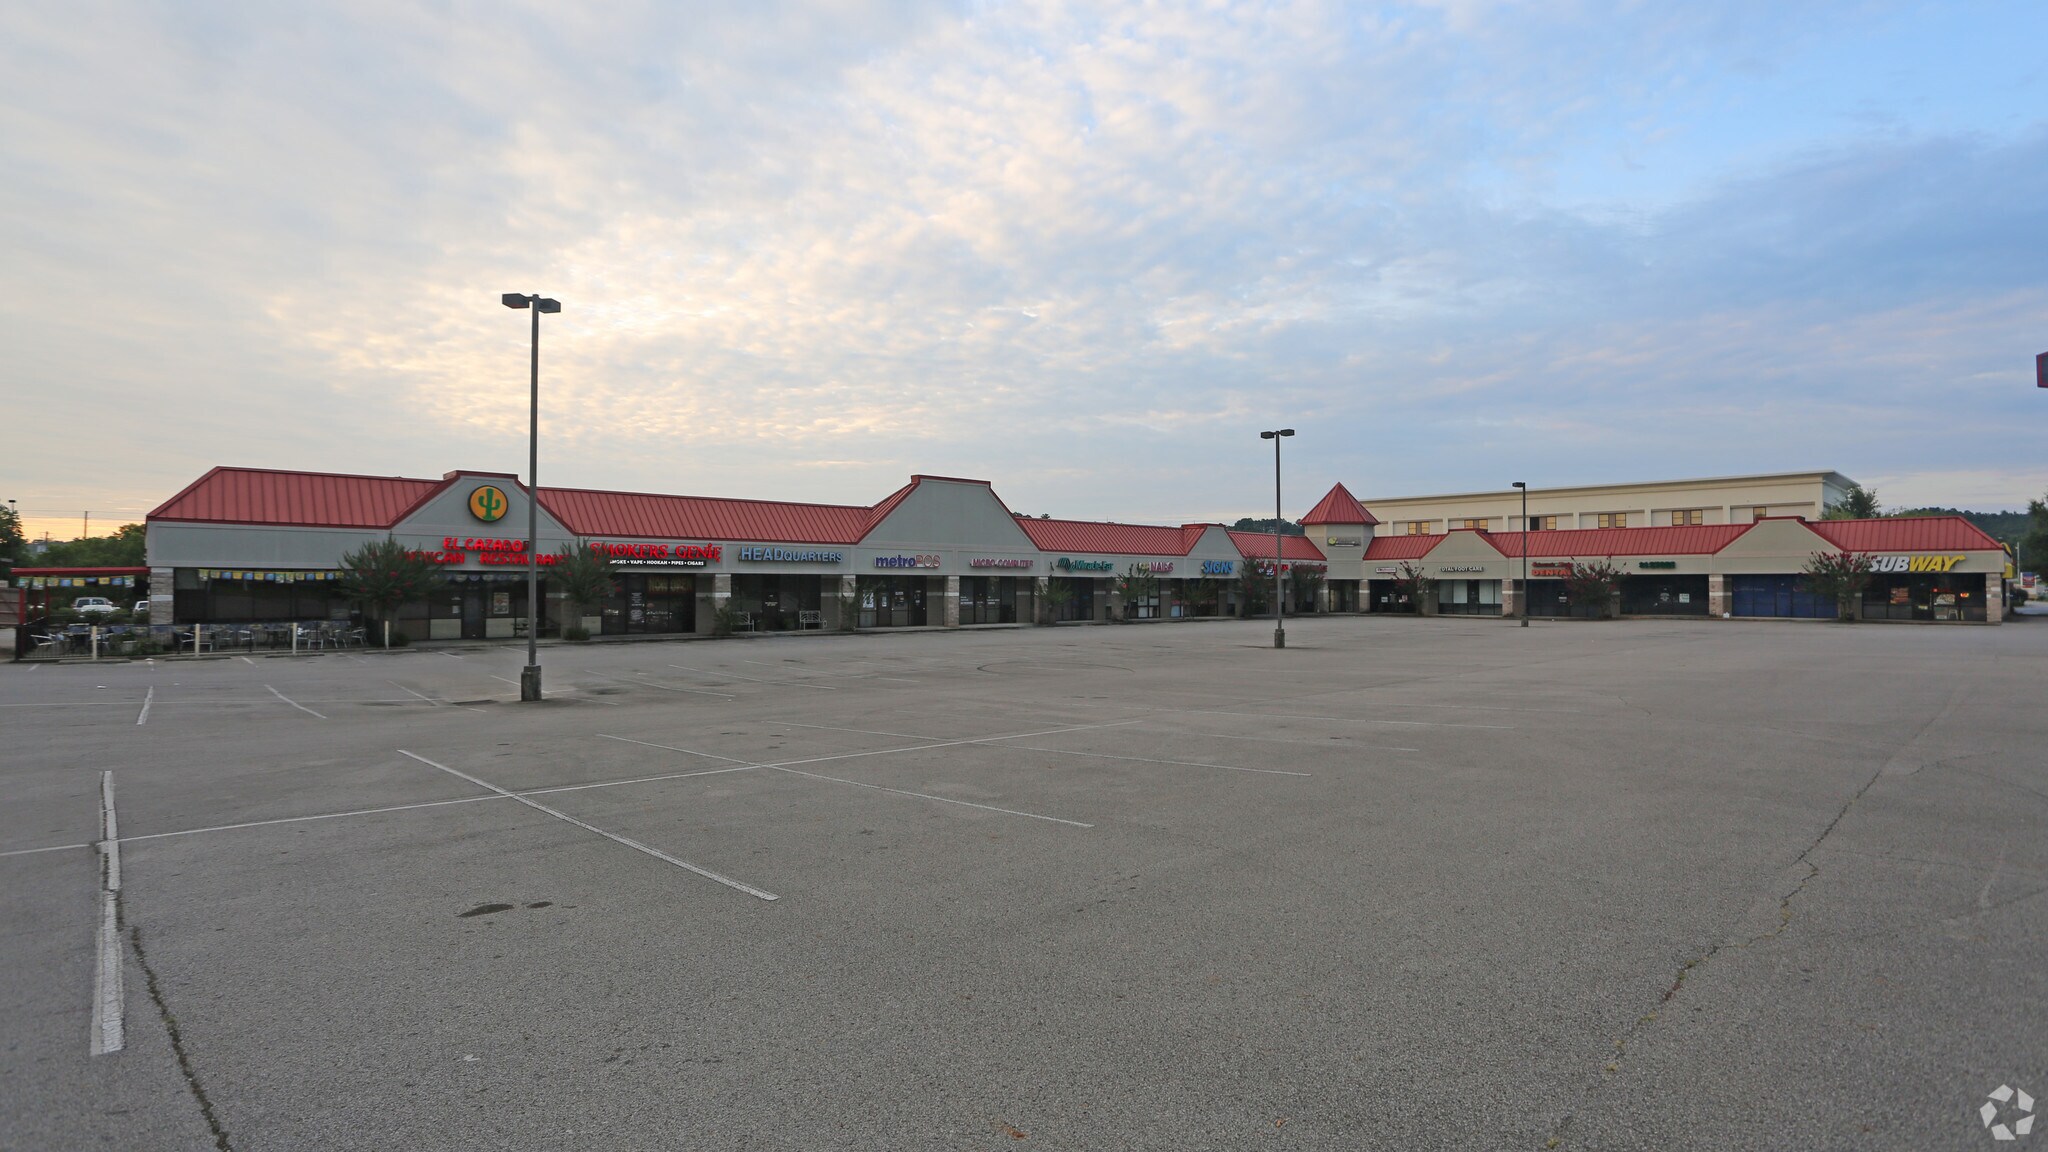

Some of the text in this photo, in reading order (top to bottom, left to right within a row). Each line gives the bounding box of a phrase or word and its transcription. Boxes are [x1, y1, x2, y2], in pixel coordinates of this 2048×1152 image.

[443, 537, 460, 550] EL
[589, 542, 669, 559] SMOKERS
[741, 547, 843, 562] HEADQUARTERS
[875, 554, 941, 568] metroPCS
[1073, 559, 1114, 571] Miracle-Ear
[1150, 561, 1174, 573] NAILS
[1202, 560, 1233, 574] SIGNS
[1869, 554, 1966, 573] SUBWAY
